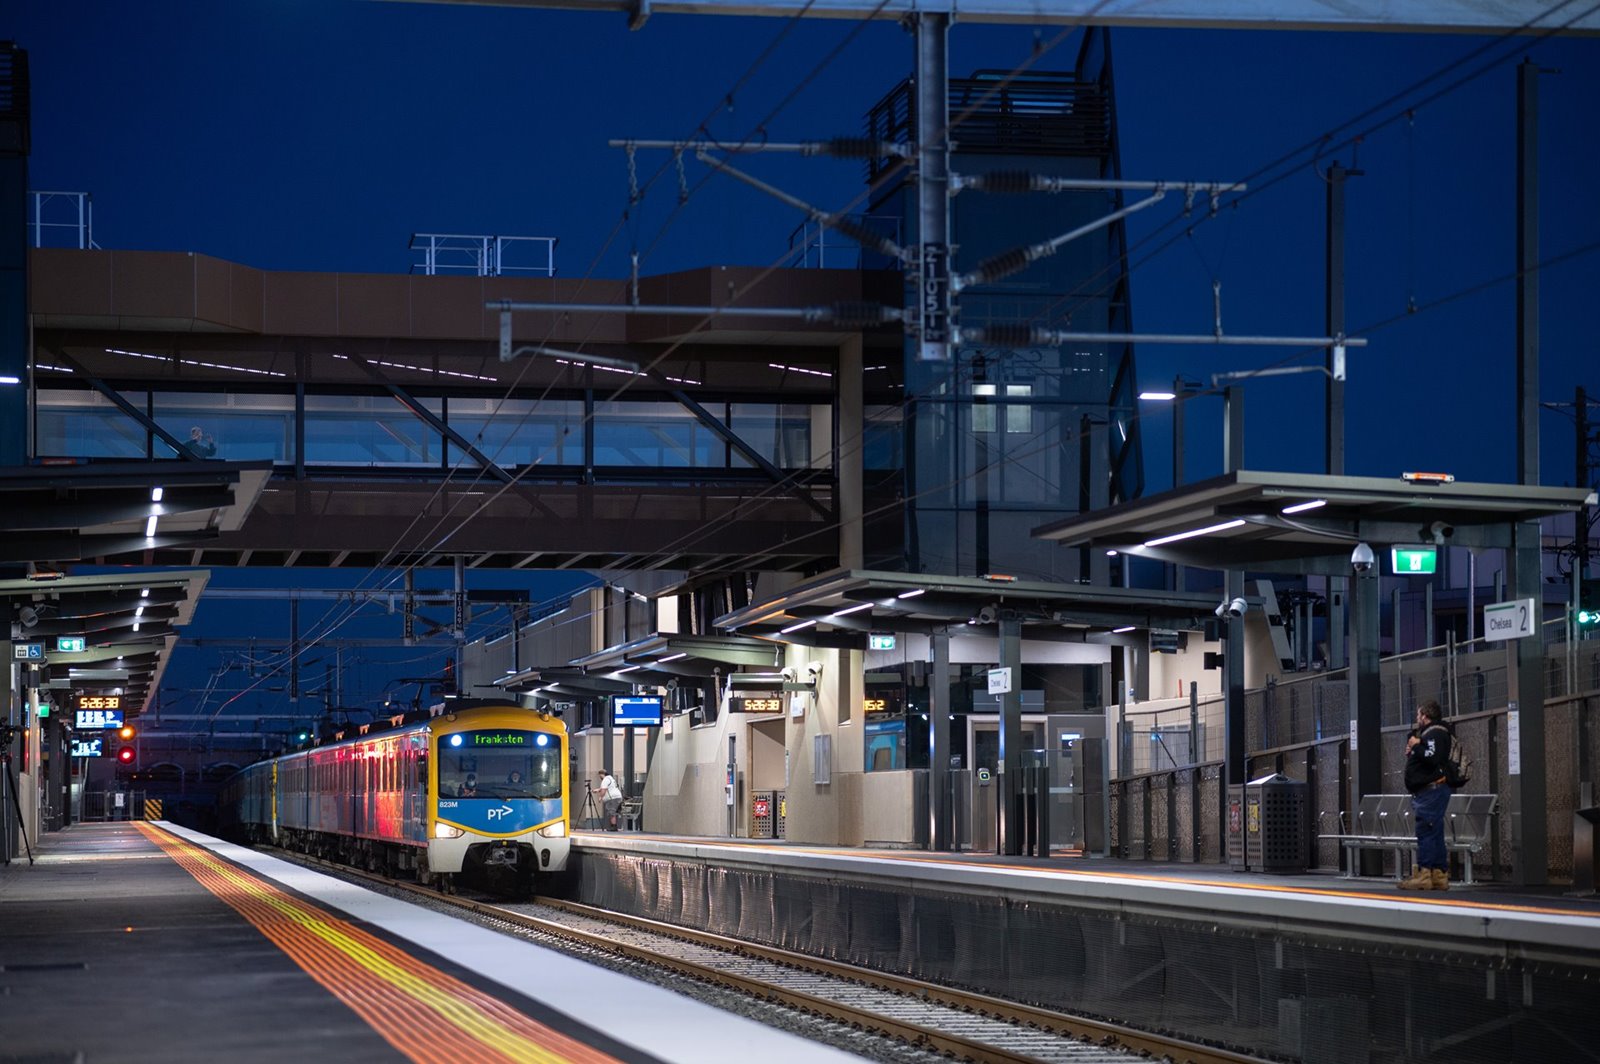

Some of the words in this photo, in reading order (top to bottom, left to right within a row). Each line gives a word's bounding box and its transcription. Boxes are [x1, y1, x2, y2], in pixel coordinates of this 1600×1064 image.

[1490, 617, 1512, 631] Chelsea
[1519, 605, 1527, 632] 2
[80, 697, 119, 709] 5:26:38
[744, 699, 779, 711] 5:26:38
[475, 734, 523, 745] Frankston
